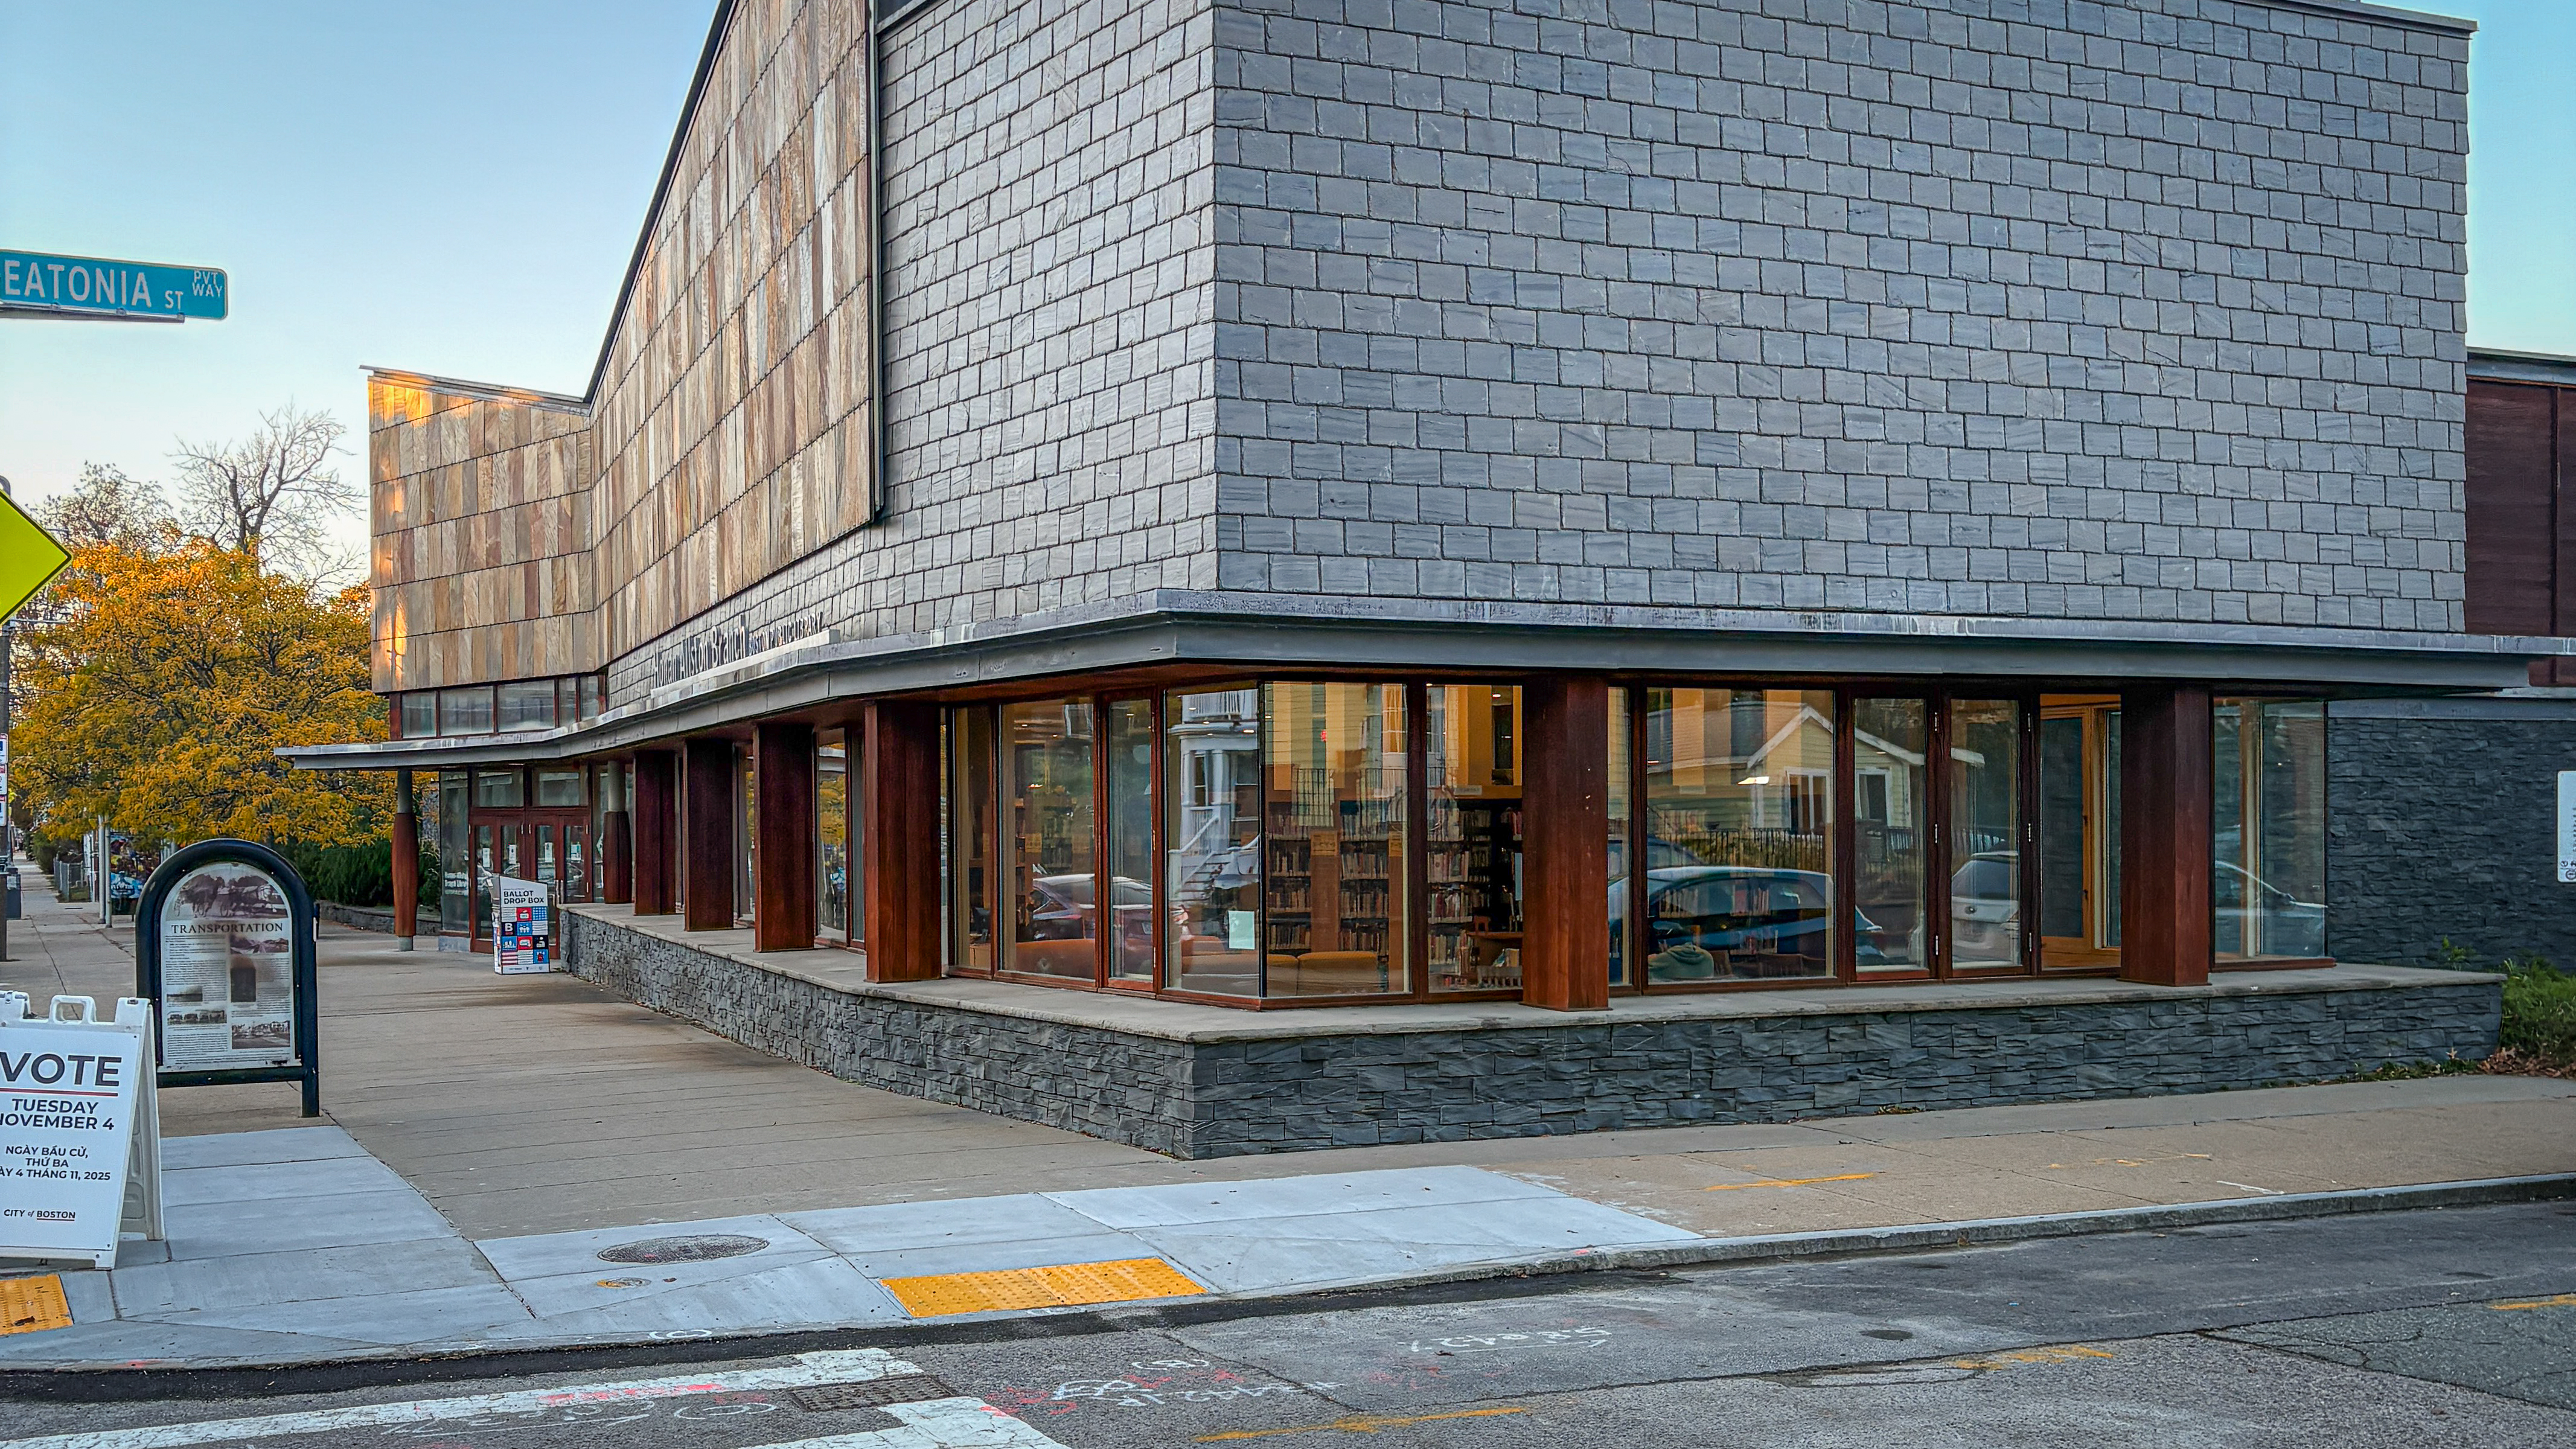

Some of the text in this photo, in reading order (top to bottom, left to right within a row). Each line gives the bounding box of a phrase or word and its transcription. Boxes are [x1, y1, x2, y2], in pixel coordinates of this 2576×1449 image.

[194, 270, 218, 285] PVT
[5, 260, 184, 311] EATONIA ST
[192, 282, 223, 298] WAY
[711, 614, 746, 668] Branch
[793, 612, 823, 641] LIBRARY
[171, 923, 283, 934] TRANSPORTATION
[0, 1052, 122, 1086] VOTE
[12, 1098, 98, 1114] TUESDAY
[102, 1118, 115, 1130] 4
[5, 1145, 39, 1155] NGÀY
[53, 1159, 69, 1168] BA
[16, 1169, 24, 1177] 4
[27, 1168, 67, 1179] THÁNG
[70, 1171, 81, 1180] 11,
[84, 1171, 111, 1180] 2025
[4, 1209, 25, 1217] CITY
[37, 1210, 76, 1218] BOSTON
